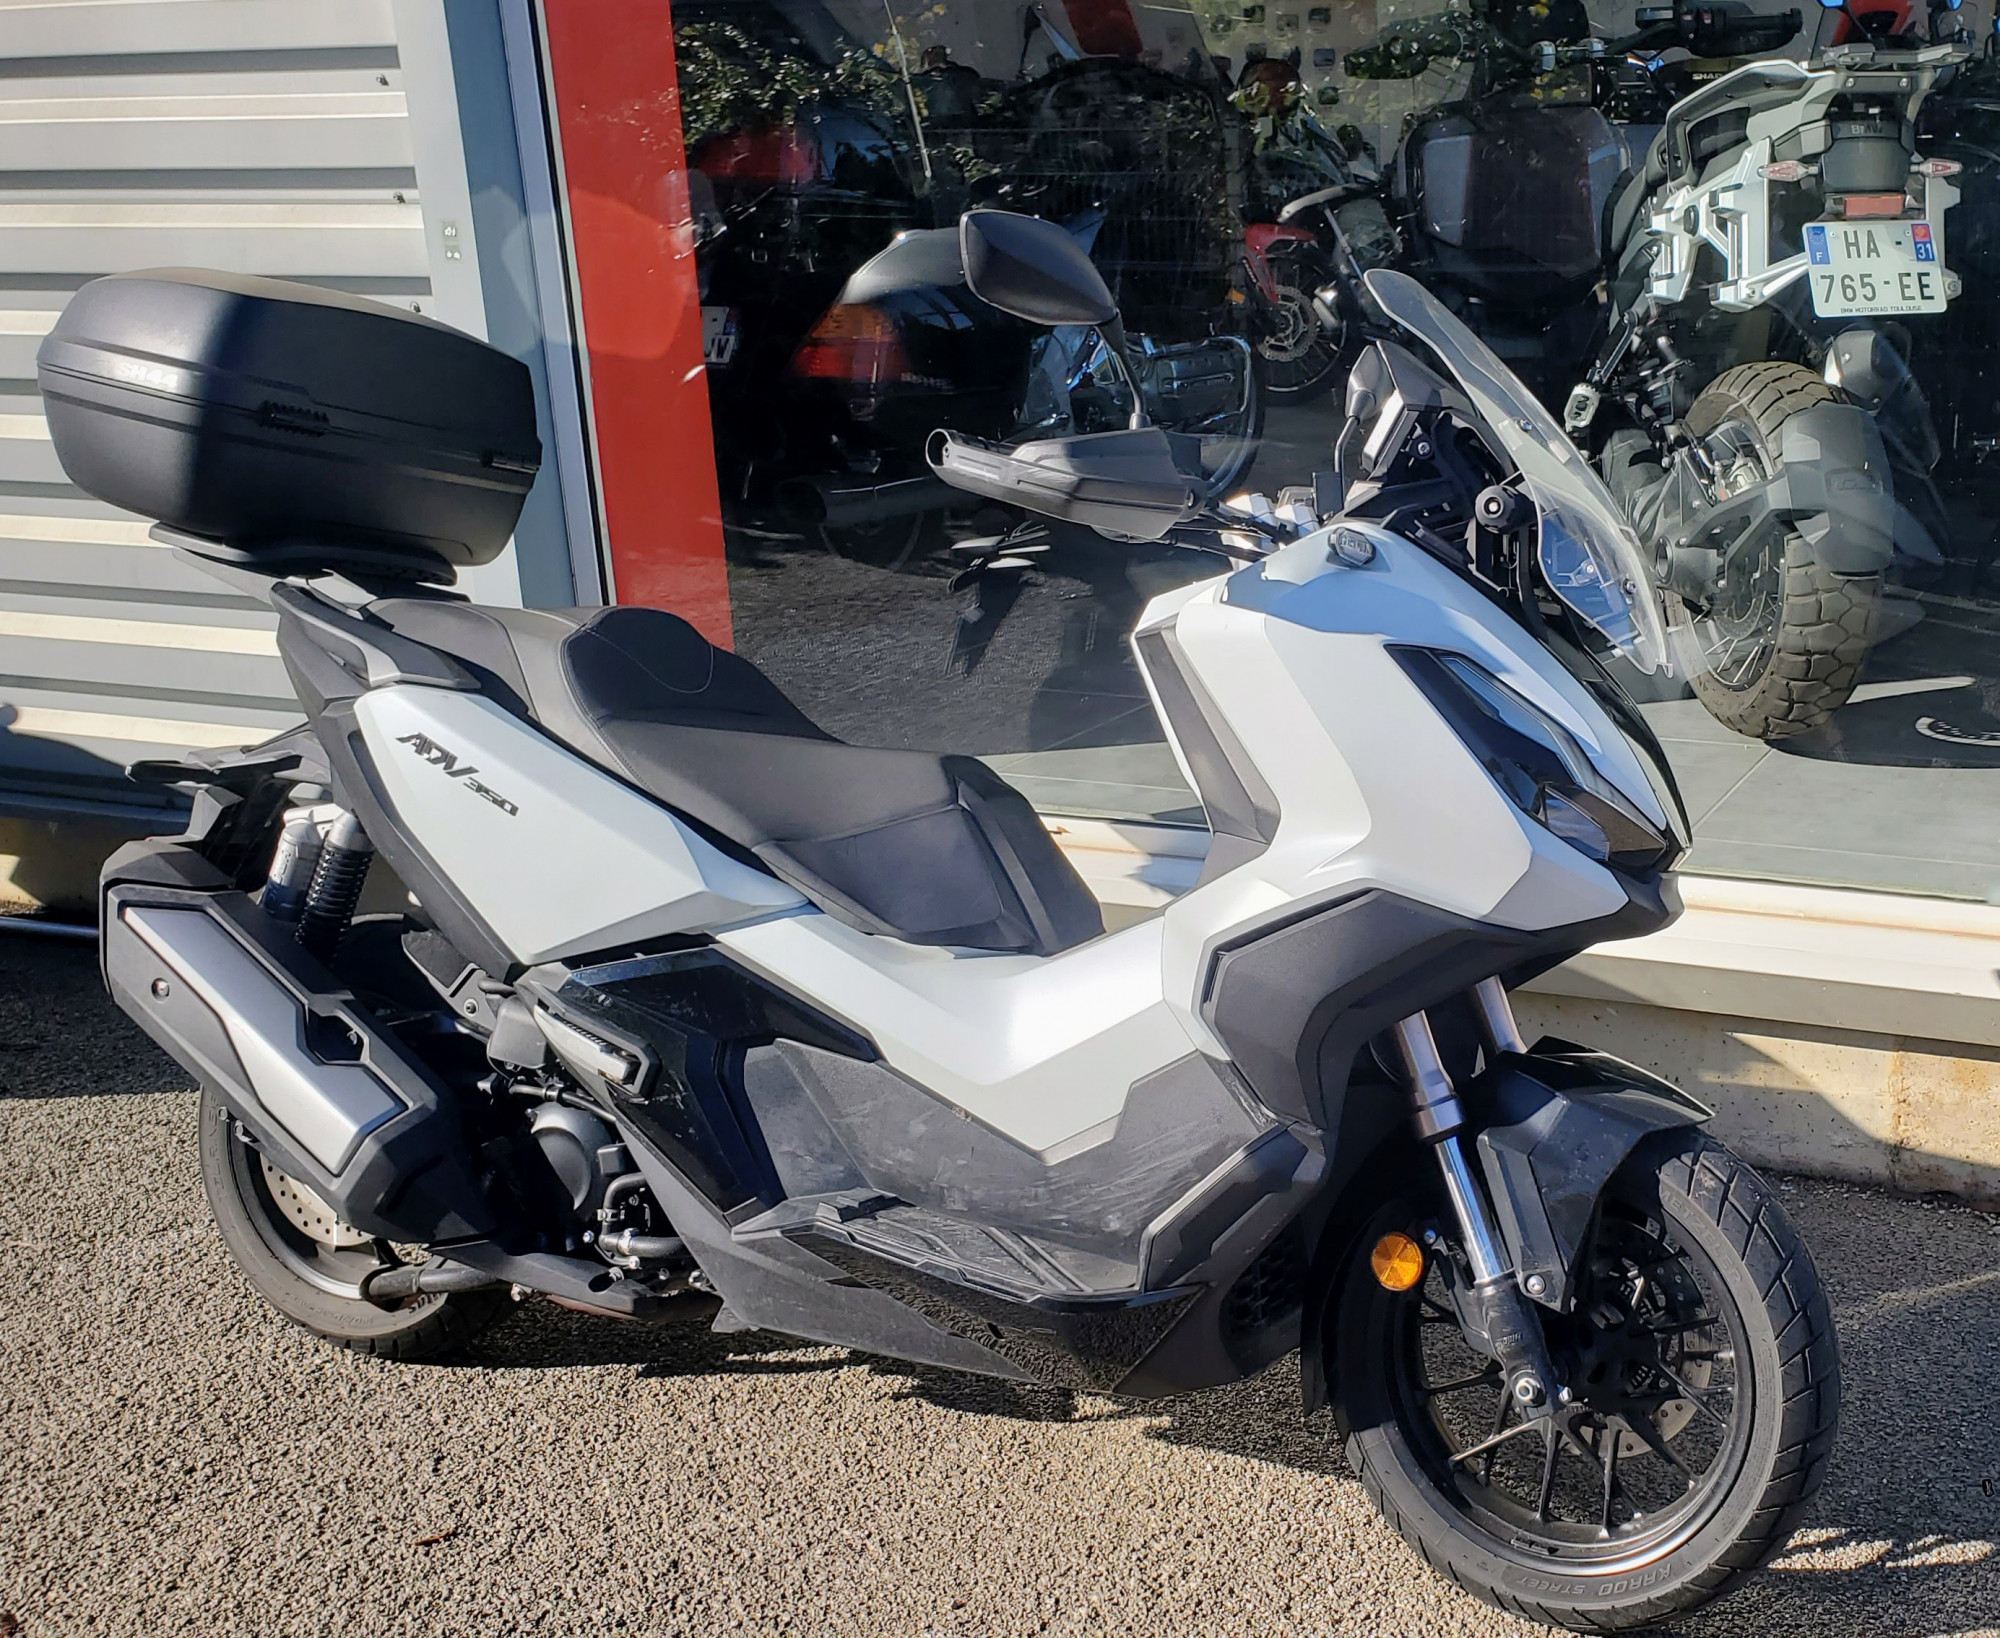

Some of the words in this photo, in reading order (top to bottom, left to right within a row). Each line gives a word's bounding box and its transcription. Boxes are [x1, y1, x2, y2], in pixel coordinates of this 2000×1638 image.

[1851, 124, 1883, 135] BMW
[1844, 230, 1881, 259] HA
[1916, 243, 1934, 260] 31
[1816, 252, 1823, 262] F
[1820, 271, 1935, 304] 765-EE
[1516, 1575, 1587, 1595] STREET
[1598, 1562, 1672, 1597] KAROO
